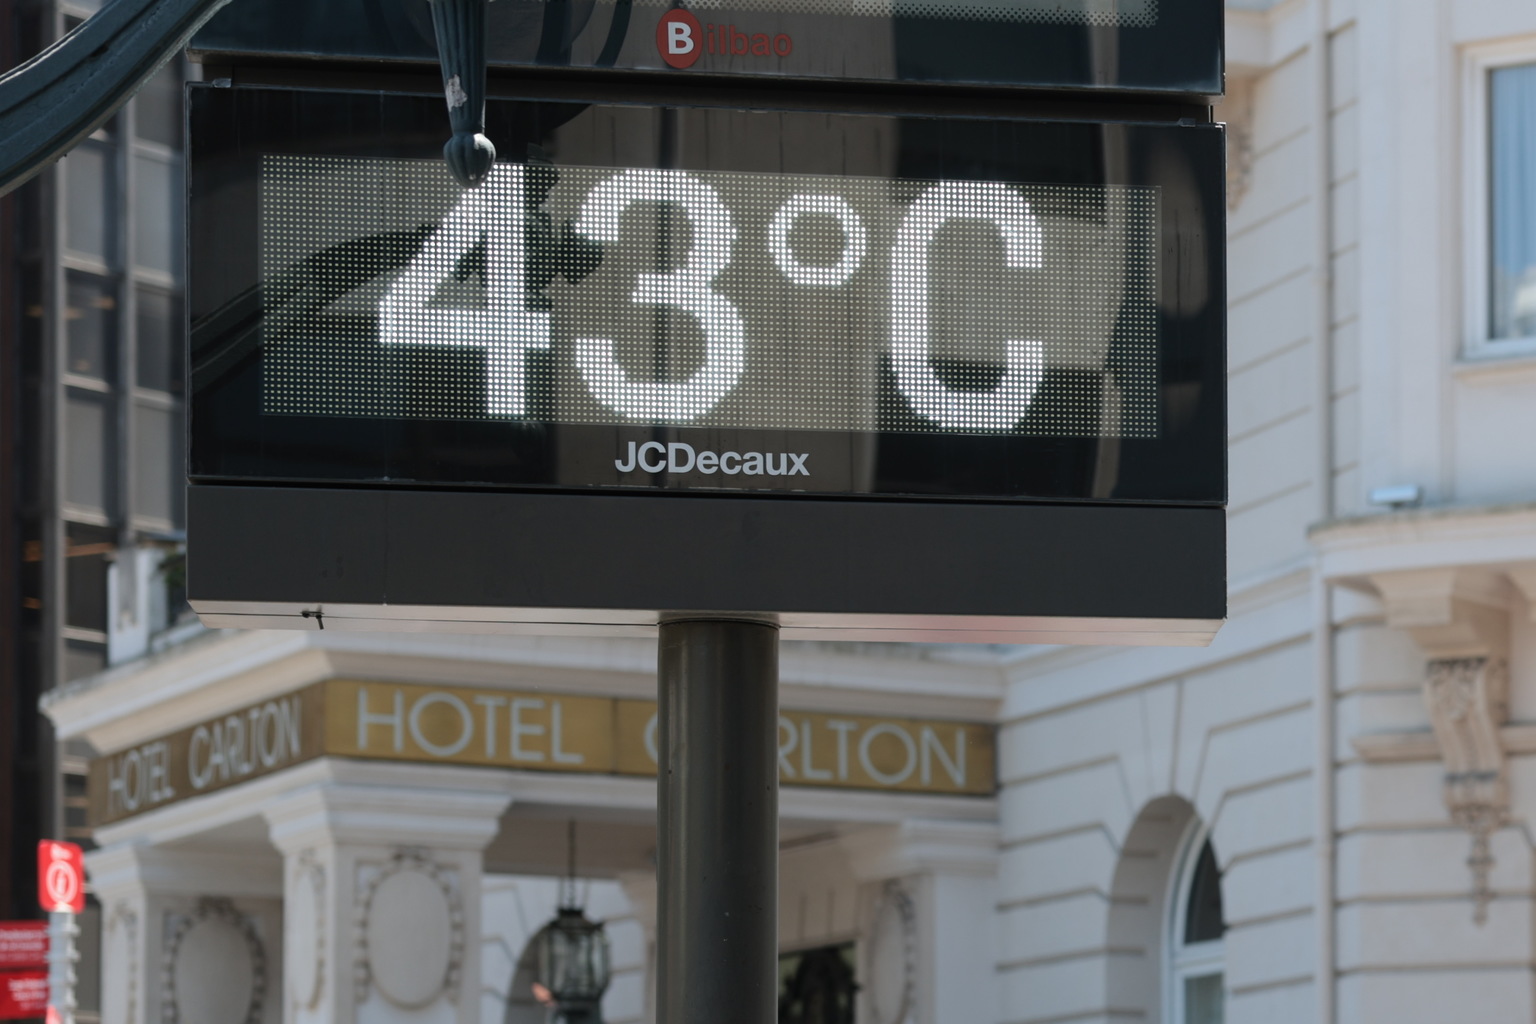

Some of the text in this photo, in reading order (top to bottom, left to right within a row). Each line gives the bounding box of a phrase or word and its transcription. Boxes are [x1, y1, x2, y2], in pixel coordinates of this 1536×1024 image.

[667, 21, 793, 57] Bilbao
[378, 163, 1045, 430] 43°C
[614, 441, 811, 476] JCDecaux
[107, 694, 303, 816] HOTEL CARLTON
[357, 687, 968, 789] HOTEL RLTON
